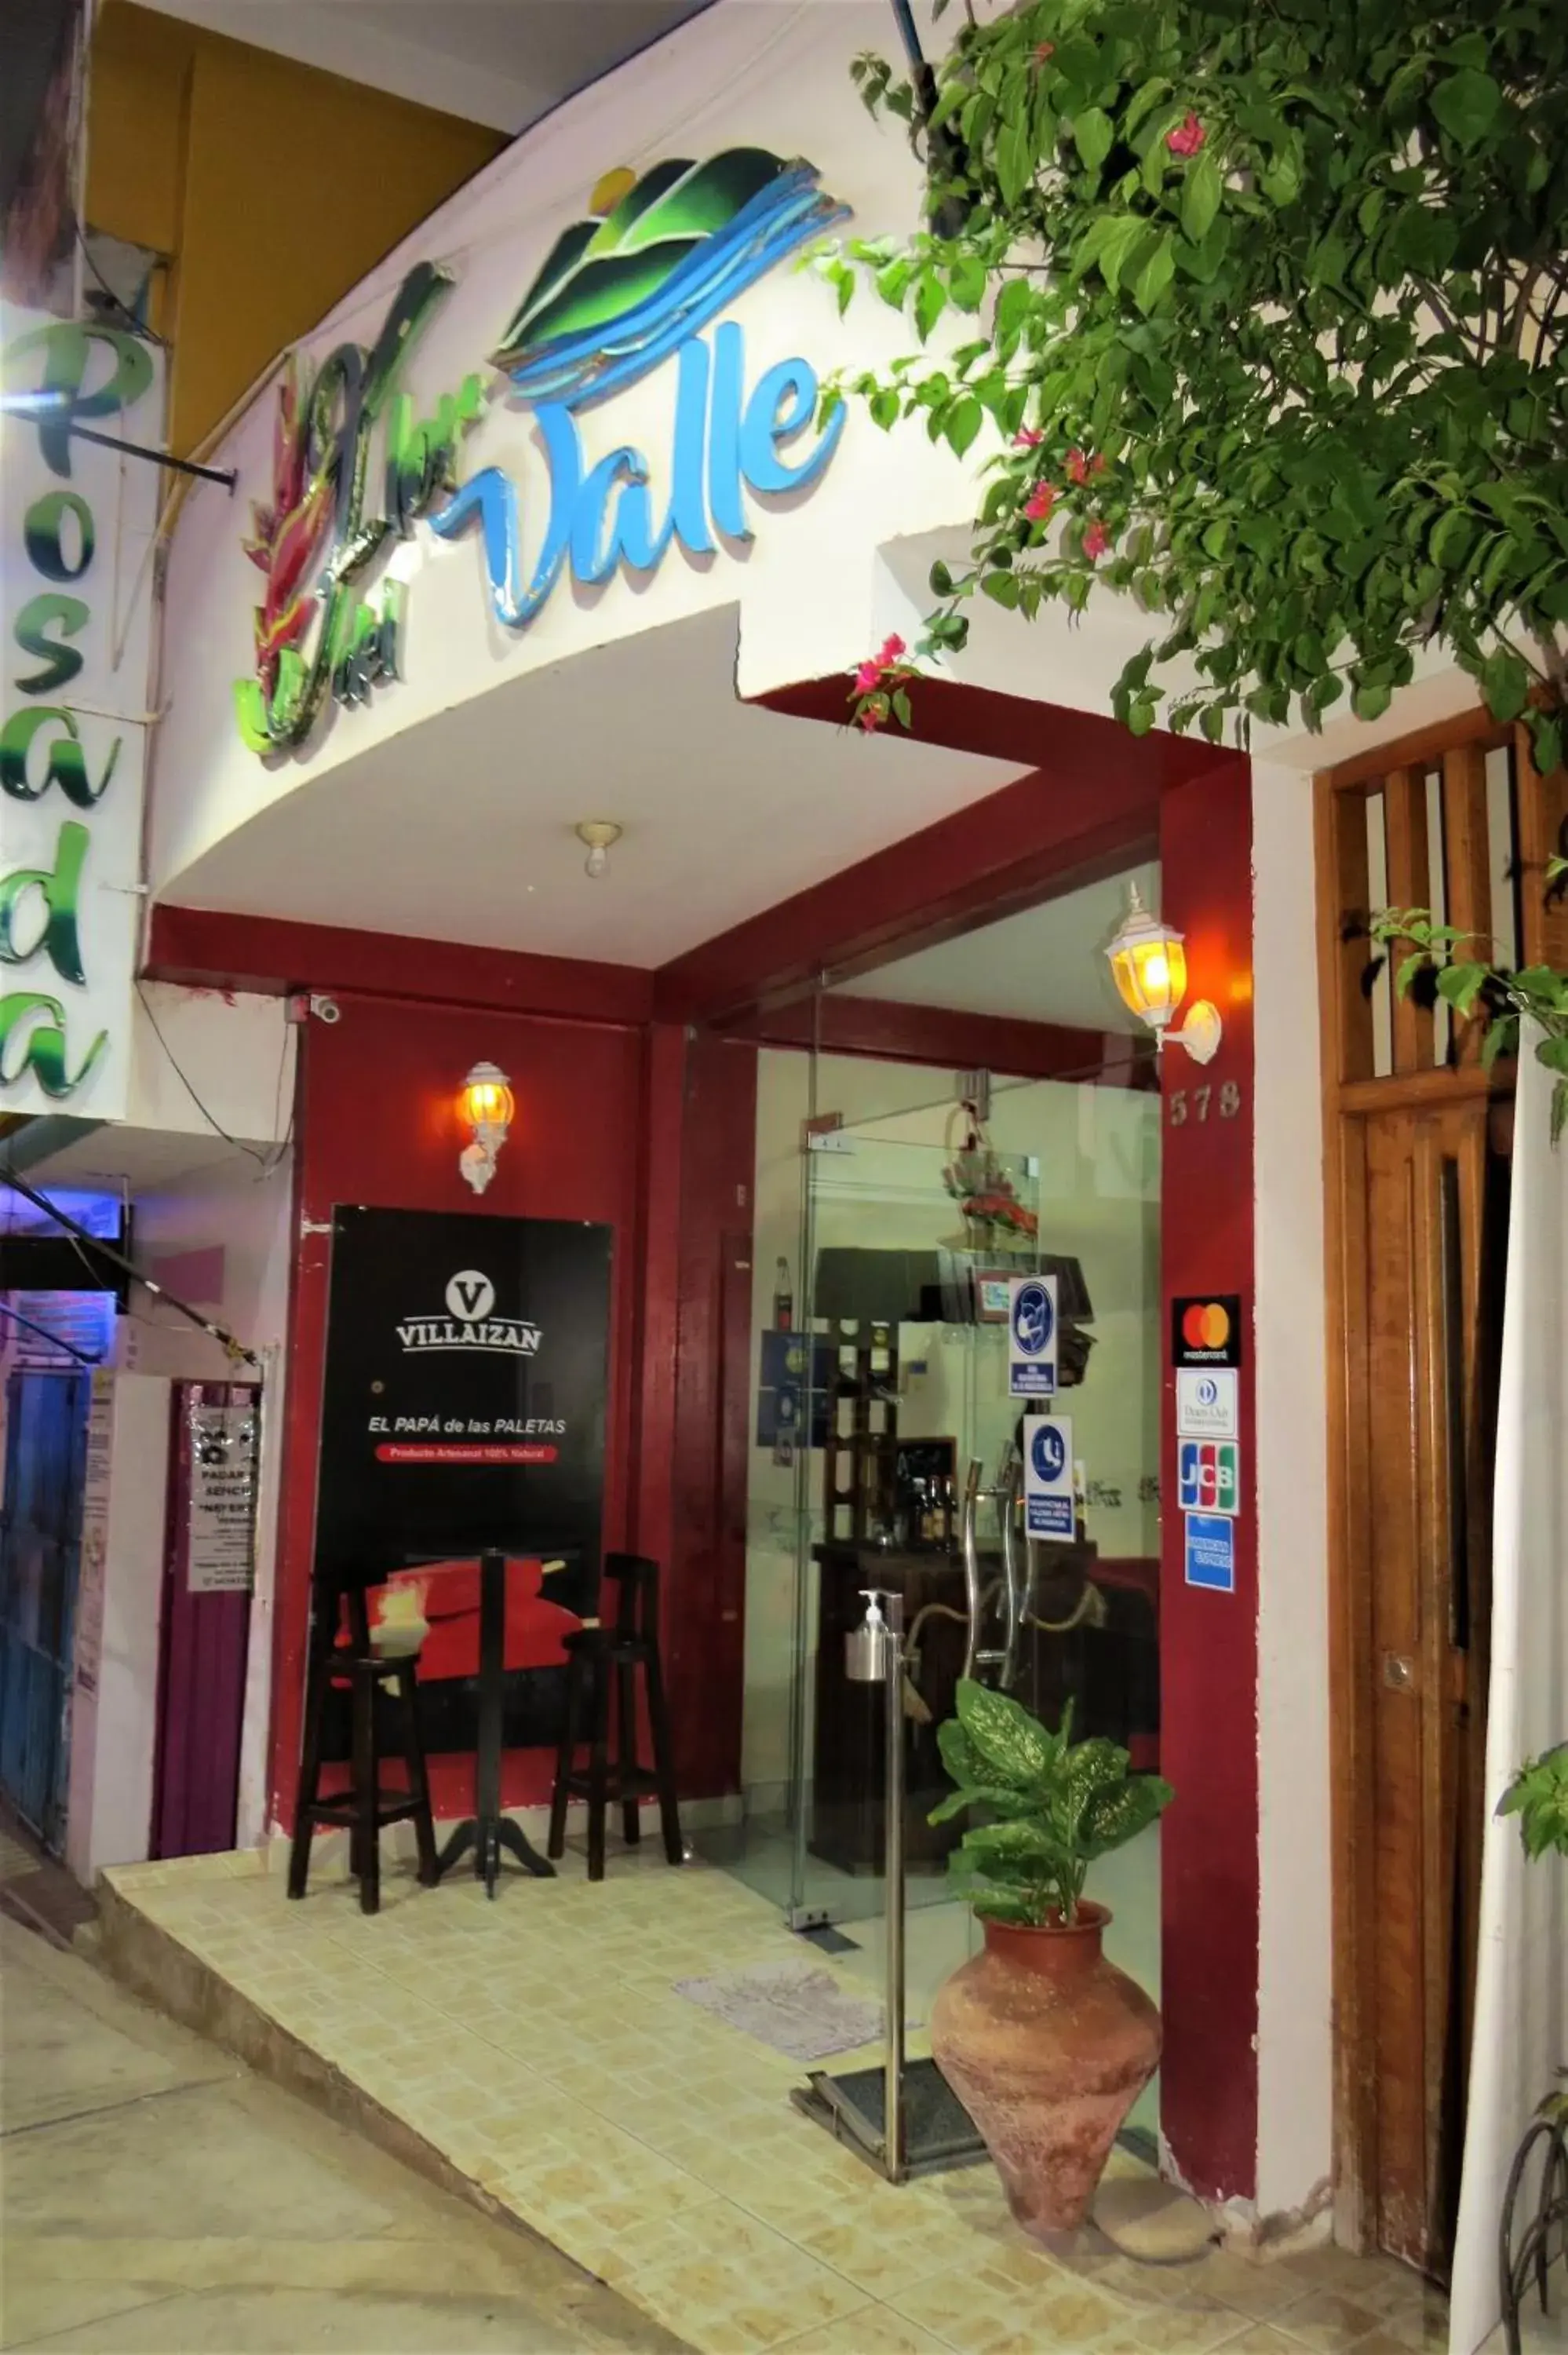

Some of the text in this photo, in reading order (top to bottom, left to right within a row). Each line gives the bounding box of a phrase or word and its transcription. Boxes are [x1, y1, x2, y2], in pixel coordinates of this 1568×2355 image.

[429, 320, 846, 627] Valle
[0, 320, 154, 1097] Posada
[1169, 1080, 1241, 1127] 578
[454, 1280, 487, 1315] V
[396, 1323, 542, 1350] VILLAIZAN
[367, 1414, 567, 1434] EL PAPÁ de las PALETAS
[1180, 1462, 1234, 1490] JCB
